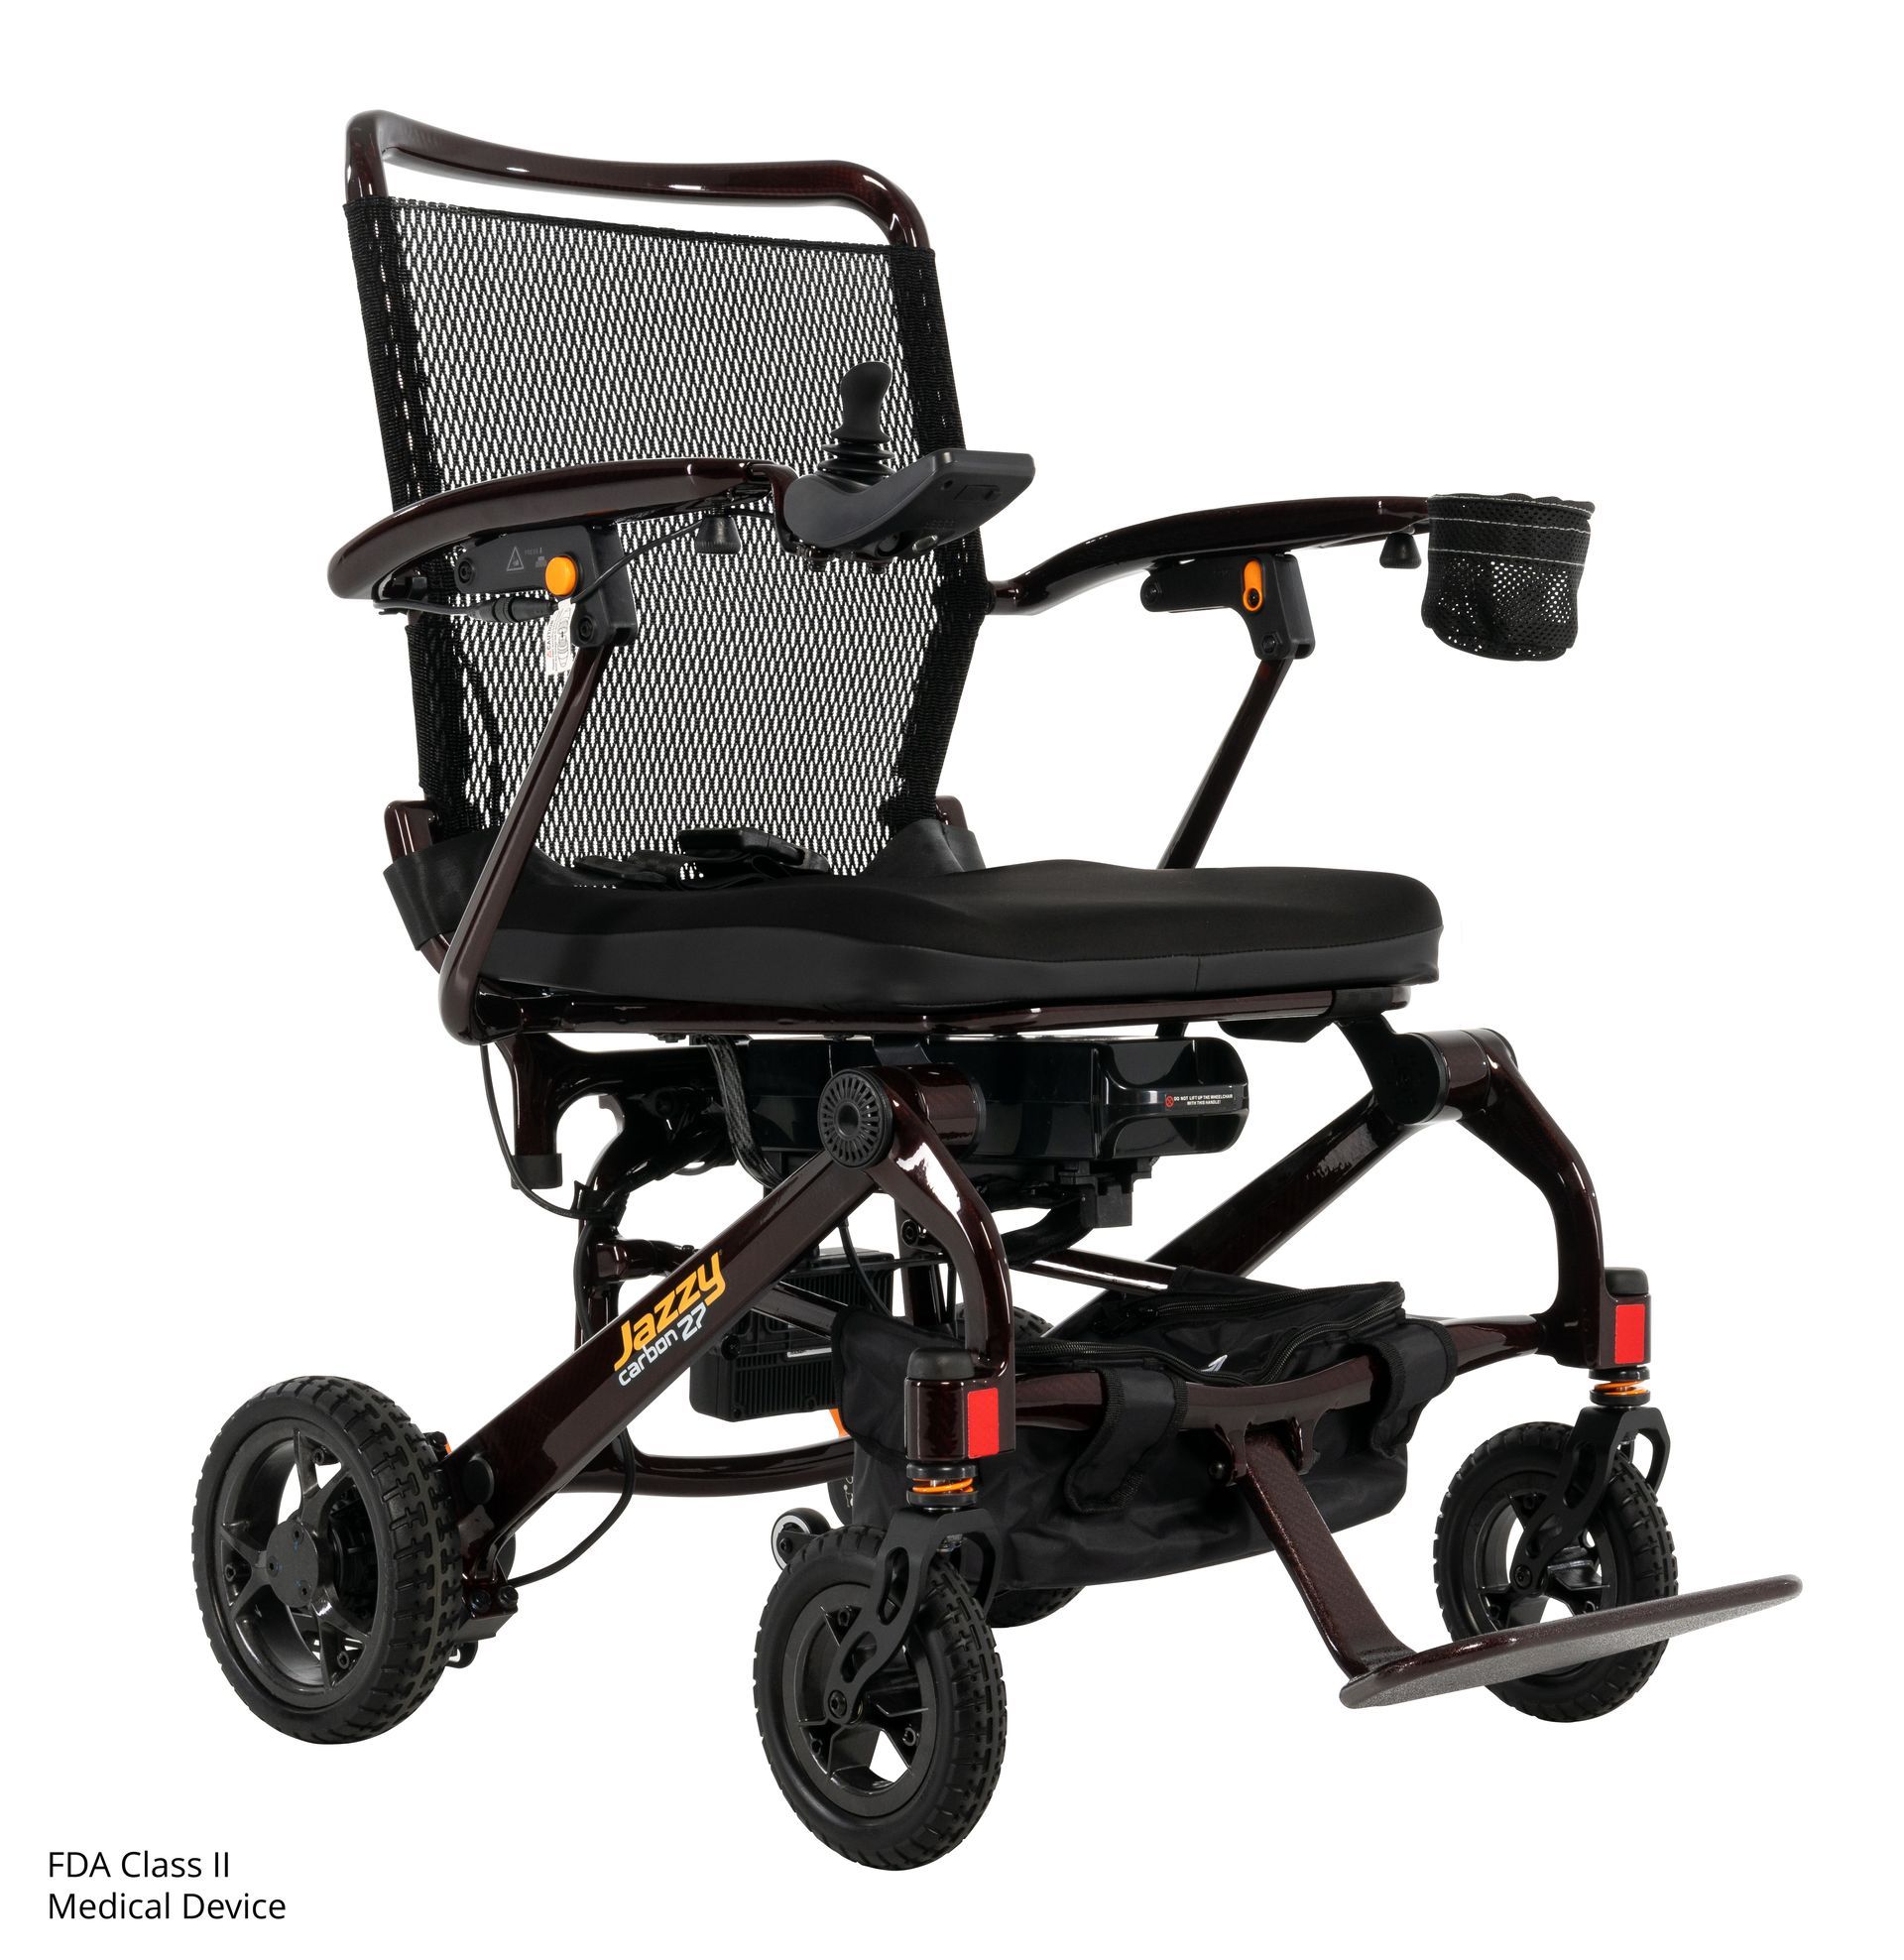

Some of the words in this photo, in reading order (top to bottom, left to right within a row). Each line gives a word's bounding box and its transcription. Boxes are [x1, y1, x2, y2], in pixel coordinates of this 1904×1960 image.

[614, 1252, 726, 1371] Jazzy
[618, 1328, 678, 1386] carbon
[676, 1301, 707, 1341] 27
